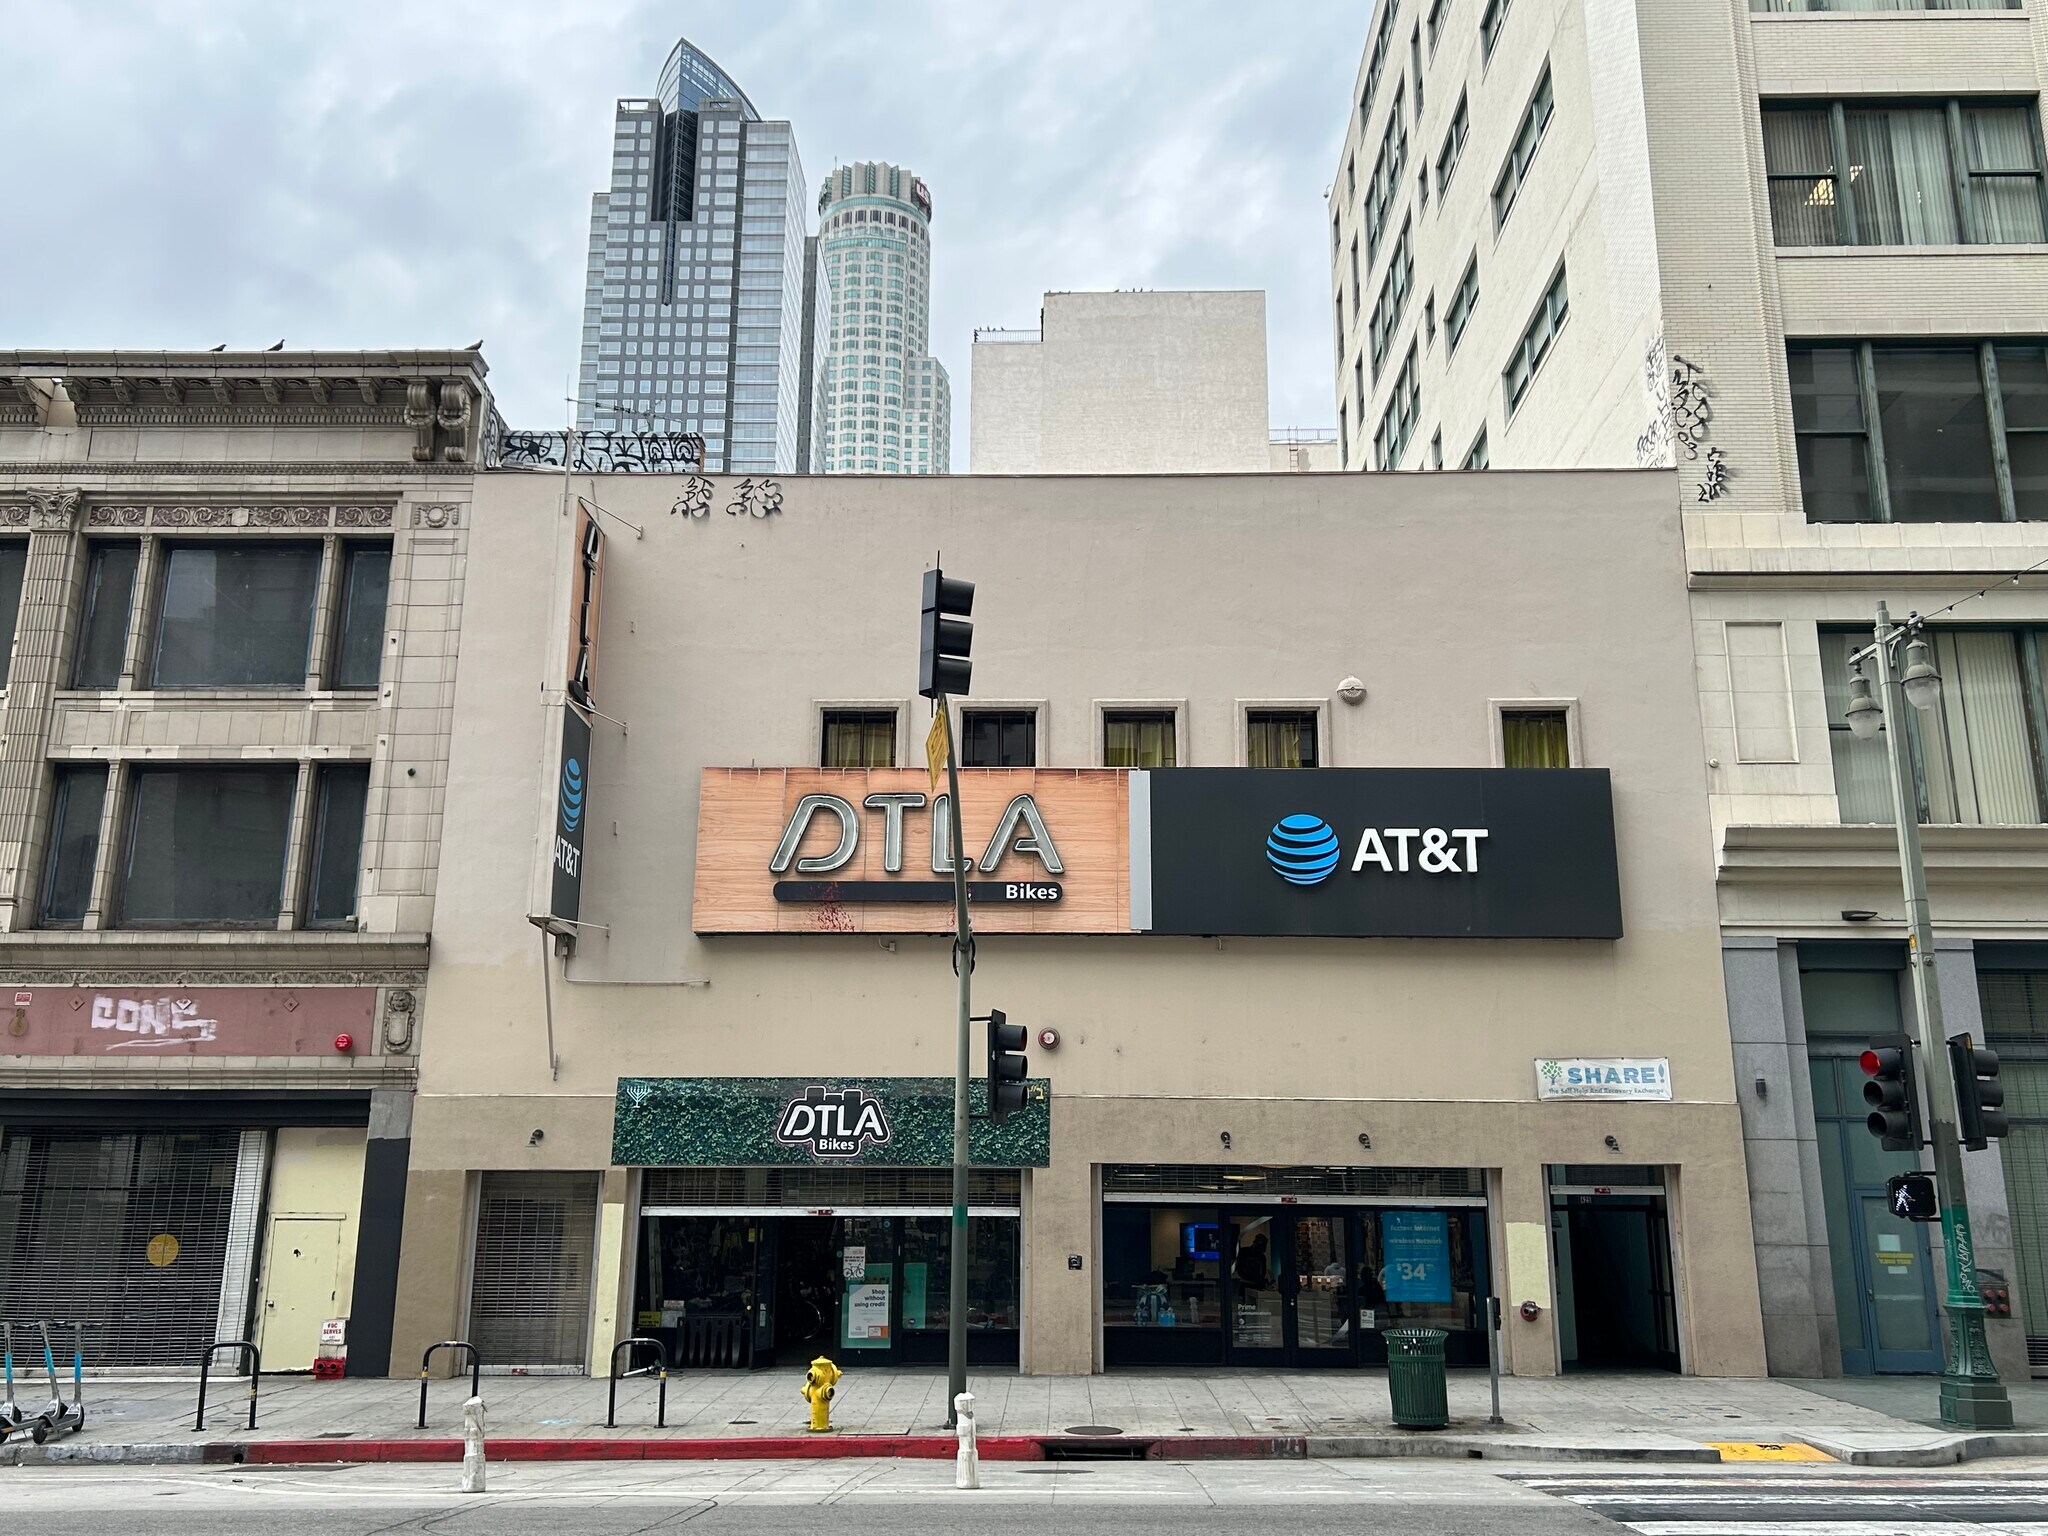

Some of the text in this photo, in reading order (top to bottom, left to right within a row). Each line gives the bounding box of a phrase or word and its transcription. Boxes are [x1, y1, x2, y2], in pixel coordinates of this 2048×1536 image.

[769, 792, 1065, 873] DTLA
[553, 835, 580, 878] AT&T
[1351, 827, 1489, 873] AT&T
[1005, 883, 1058, 900] Bikes
[1568, 1063, 1665, 1084] SHARE!
[783, 1105, 884, 1136] DTLA
[819, 1138, 855, 1150] Bikes
